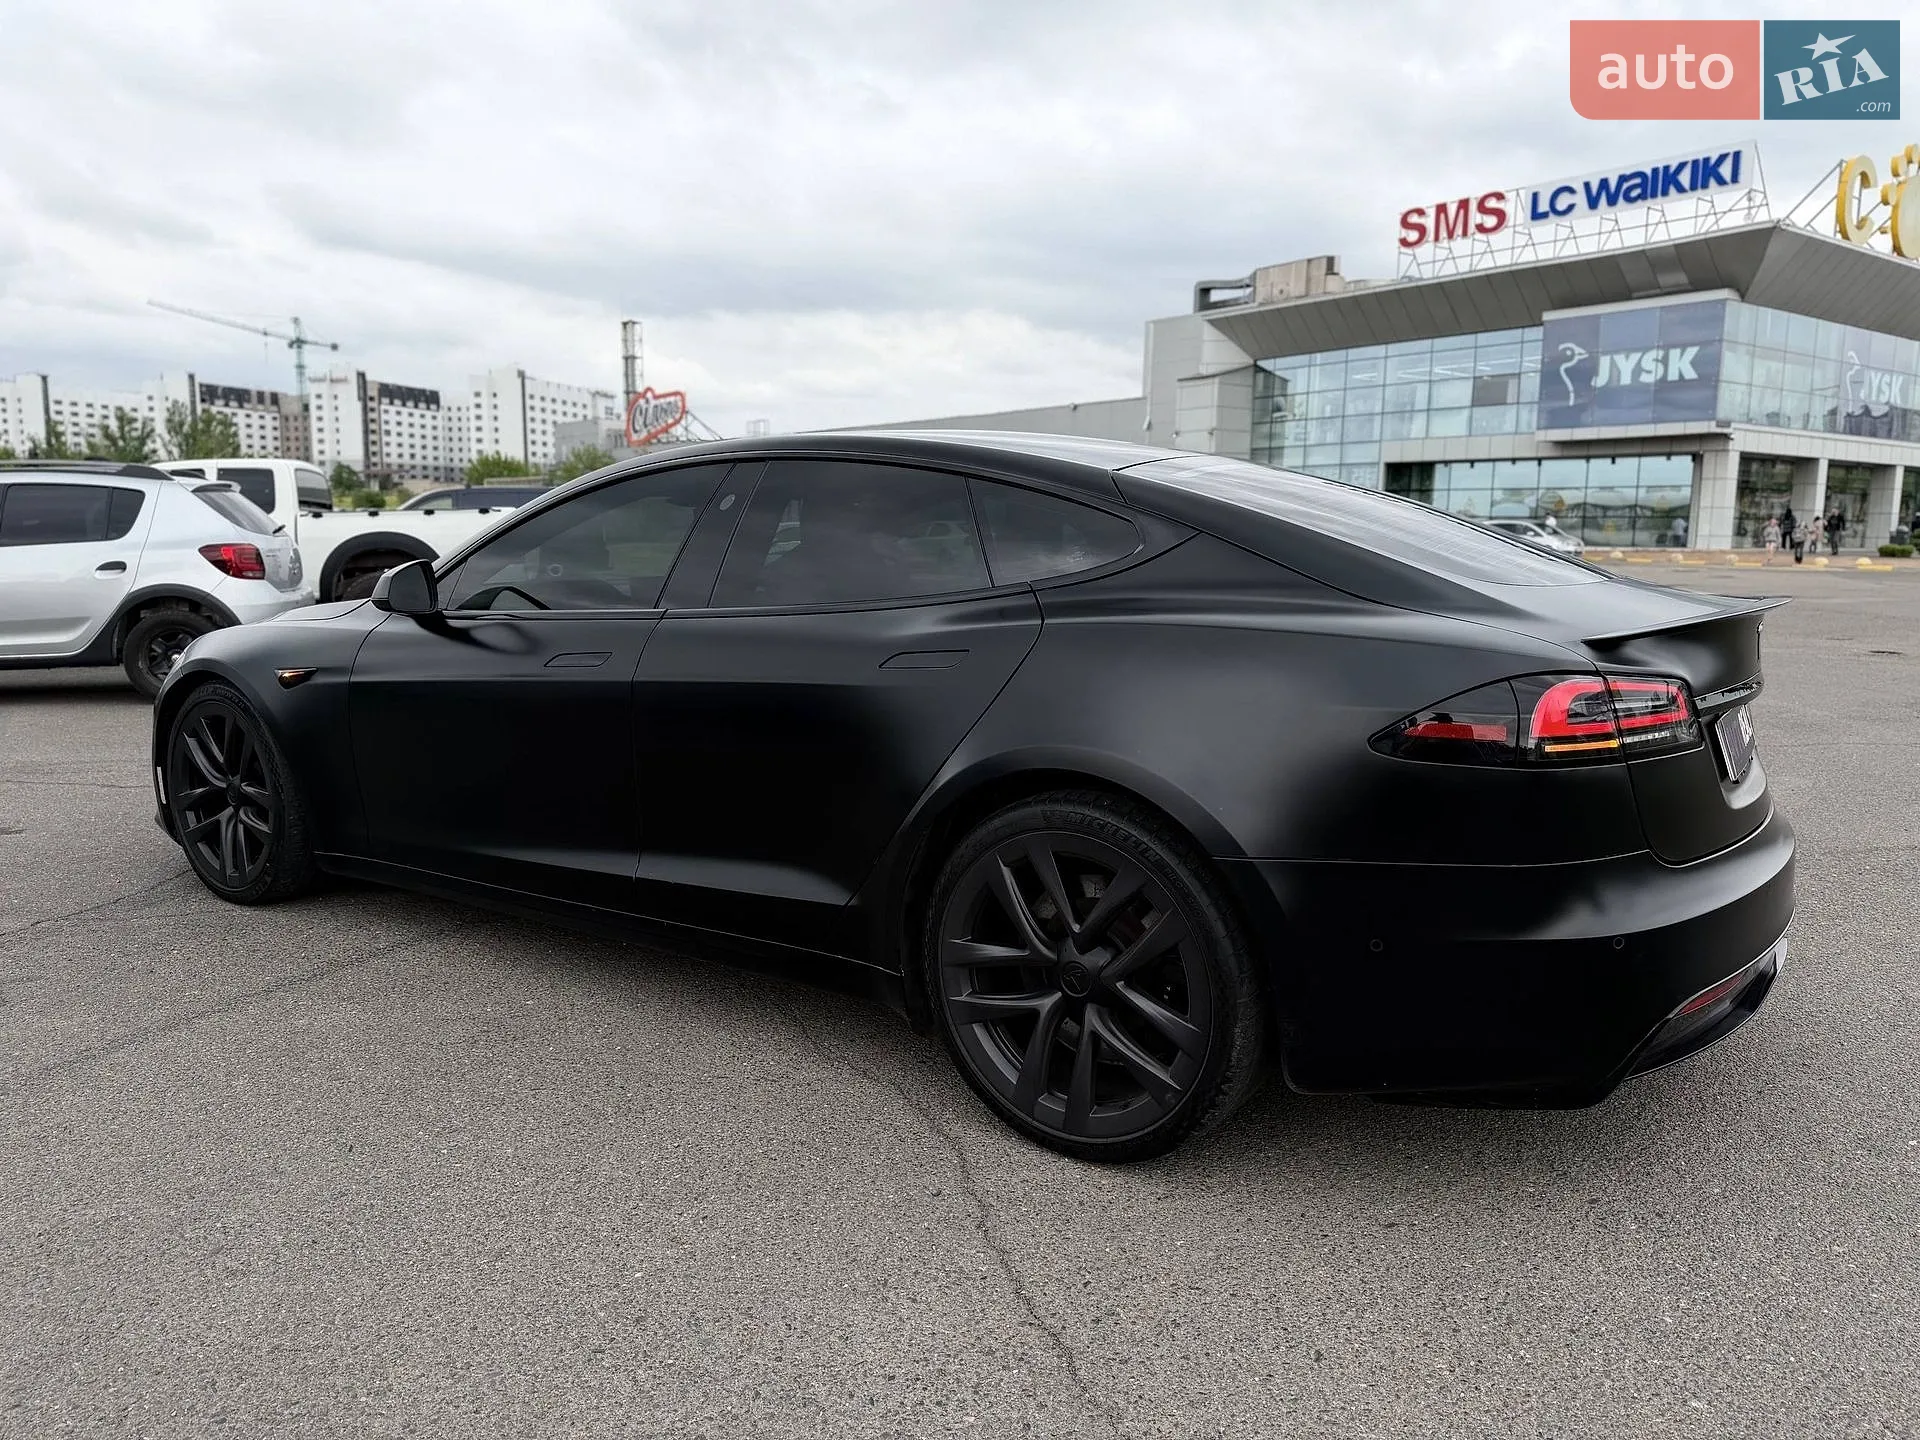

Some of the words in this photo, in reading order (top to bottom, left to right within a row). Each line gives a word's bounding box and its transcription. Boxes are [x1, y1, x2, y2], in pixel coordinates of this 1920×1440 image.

[1399, 191, 1508, 248] SMS
[1529, 184, 1579, 222] LC
[1590, 345, 1701, 389] JYSK
[1067, 811, 1161, 863] MICHELIN
